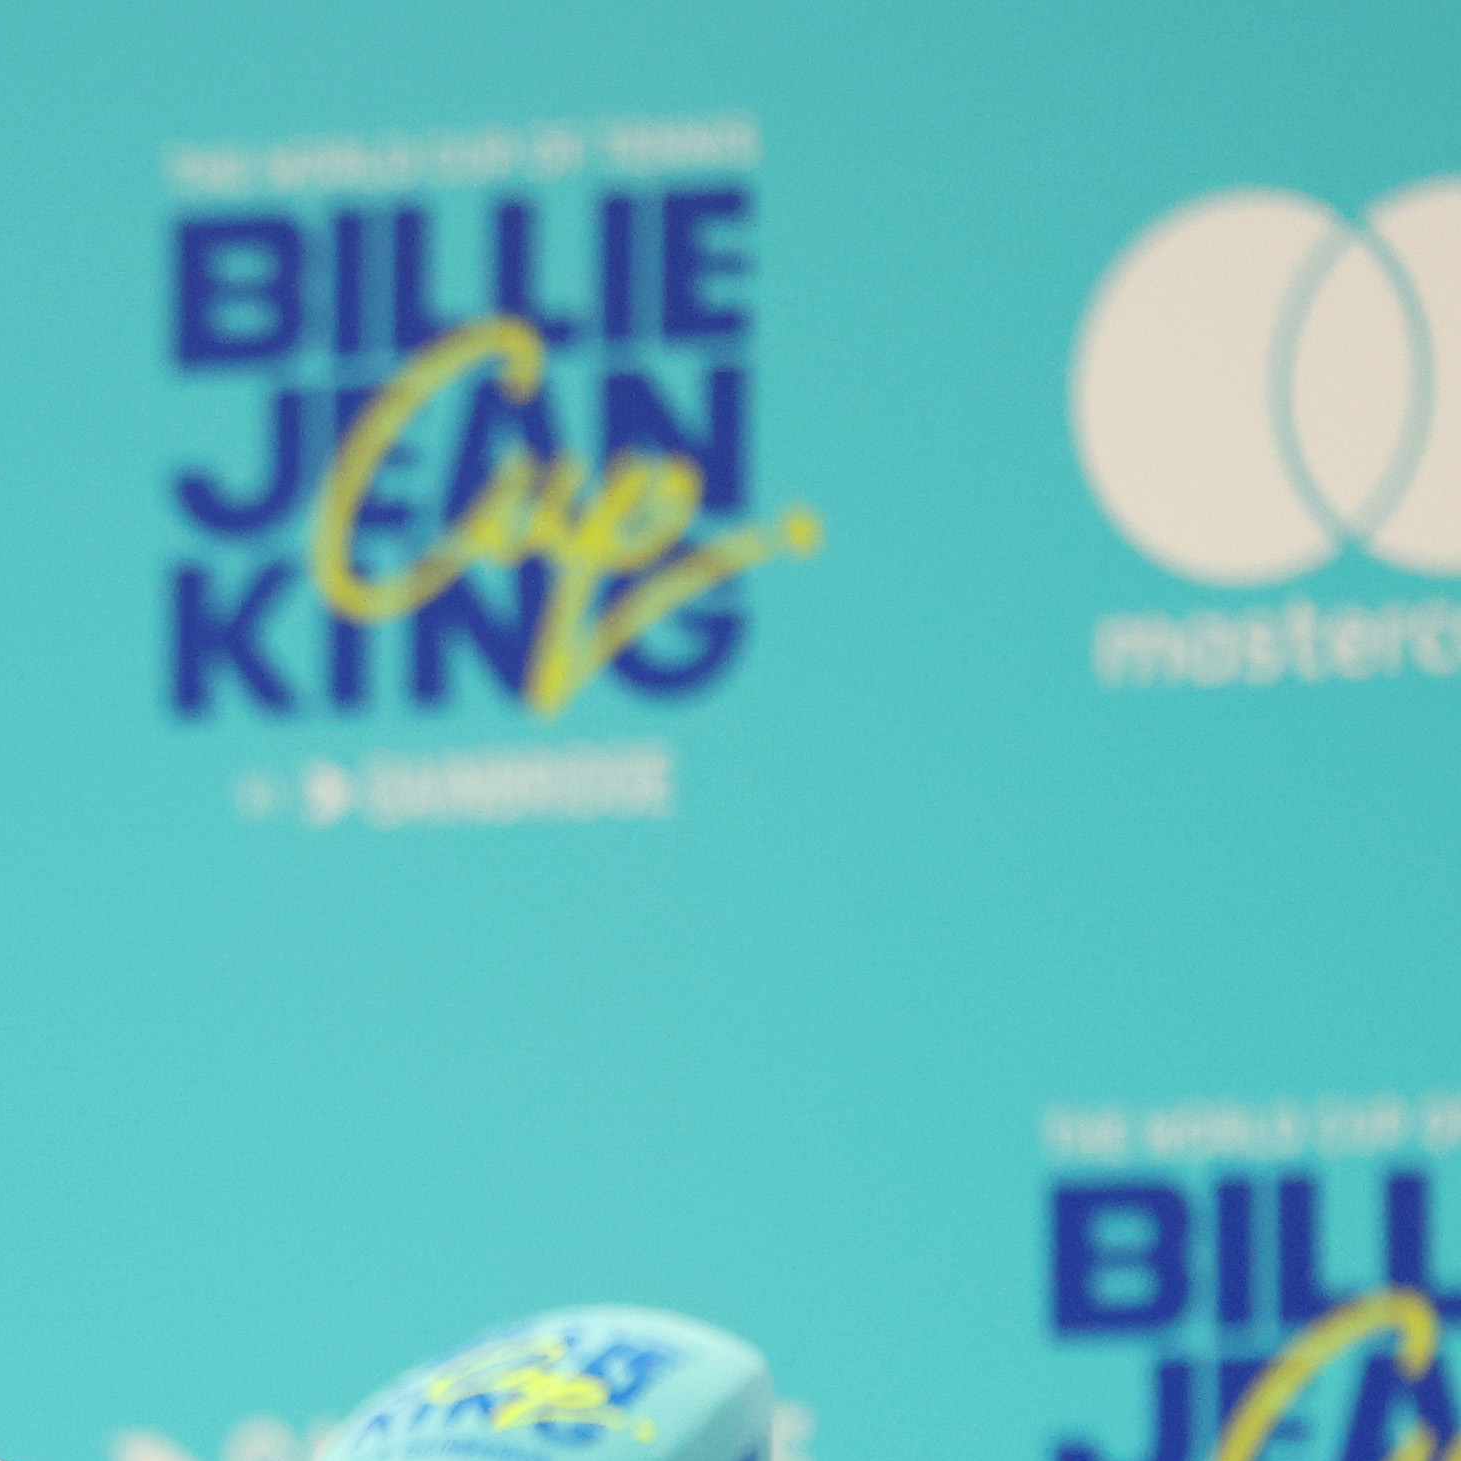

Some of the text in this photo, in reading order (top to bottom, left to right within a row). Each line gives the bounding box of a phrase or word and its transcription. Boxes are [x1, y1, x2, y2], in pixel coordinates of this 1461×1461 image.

[170, 190, 756, 368] BILLIE
[173, 365, 753, 540] JEAN
[306, 315, 823, 718] Cup
[170, 545, 750, 718] KING
